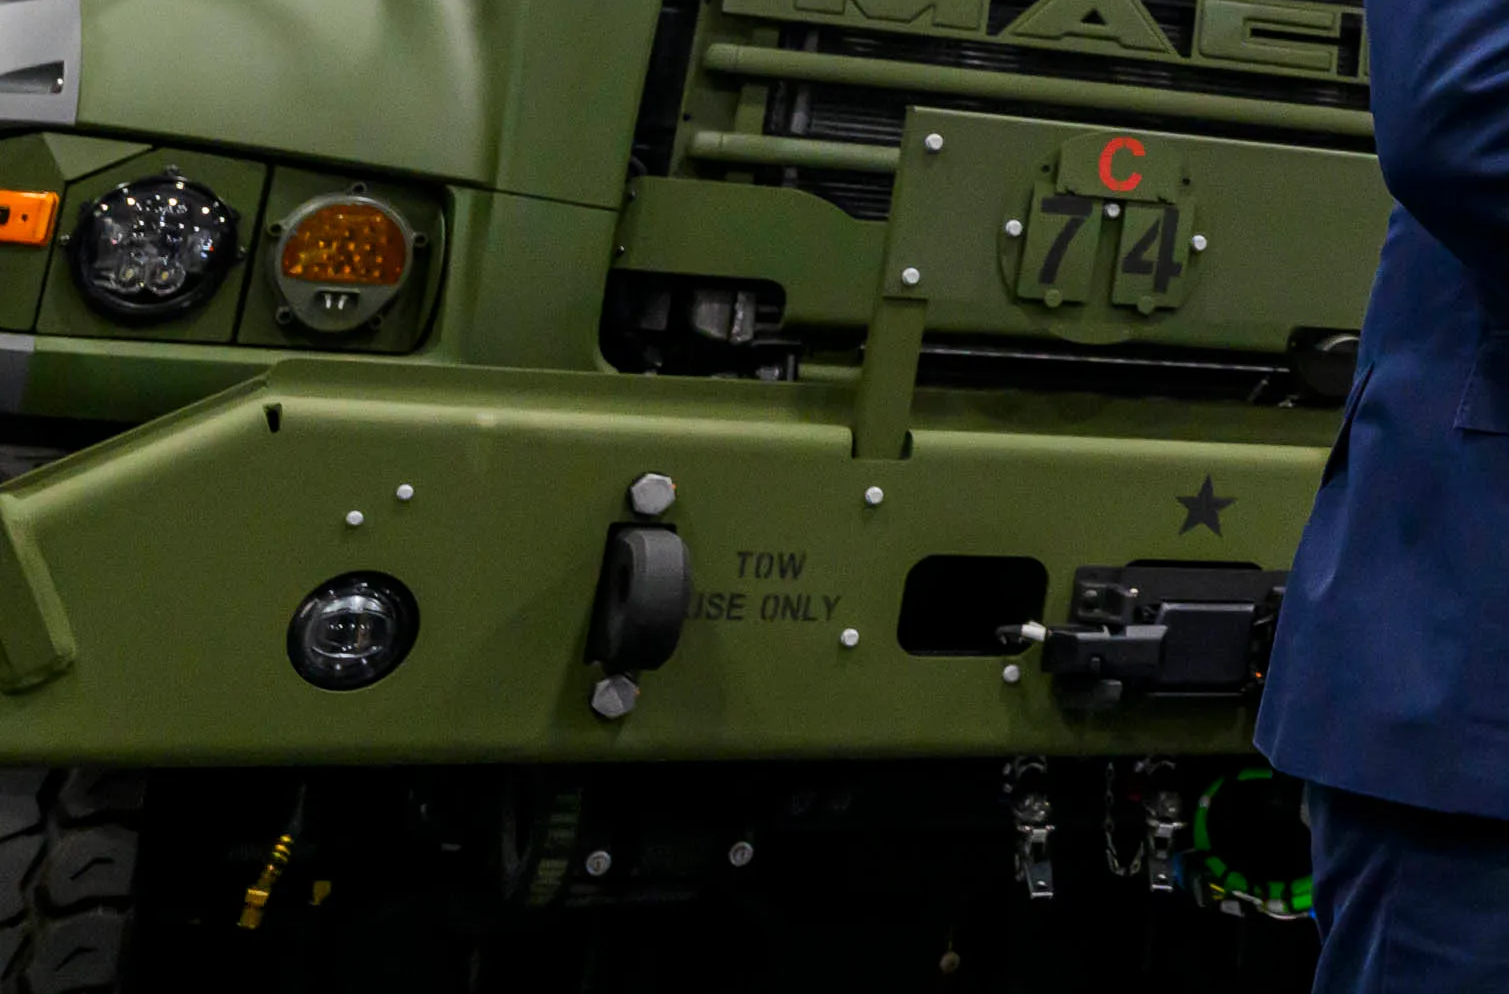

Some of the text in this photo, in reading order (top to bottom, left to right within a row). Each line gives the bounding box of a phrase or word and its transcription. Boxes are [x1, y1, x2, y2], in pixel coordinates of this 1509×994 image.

[1098, 136, 1146, 192] C
[736, 551, 807, 580] TOW
[760, 593, 841, 623] ONLY
